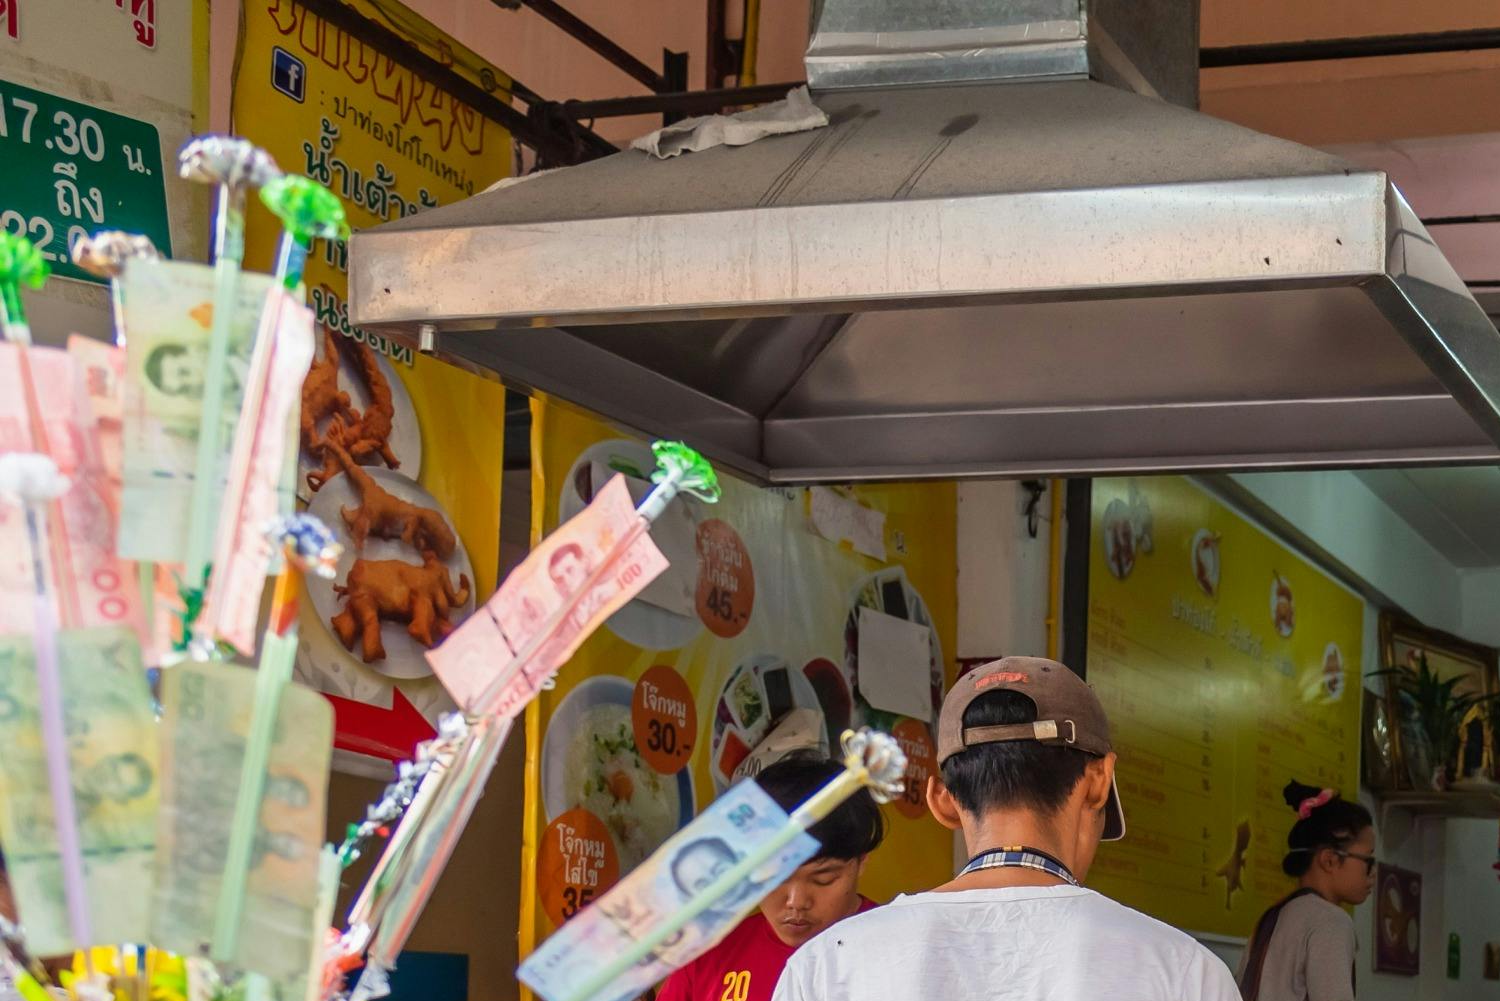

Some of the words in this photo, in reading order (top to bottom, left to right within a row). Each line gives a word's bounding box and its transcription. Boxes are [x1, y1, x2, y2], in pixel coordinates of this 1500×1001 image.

[123, 145, 151, 175] น.
[53, 162, 104, 224] ถึง
[641, 680, 687, 728] โจ๊กหมู
[646, 719, 691, 758] 30.-
[556, 823, 605, 868] โจ๊กหมู
